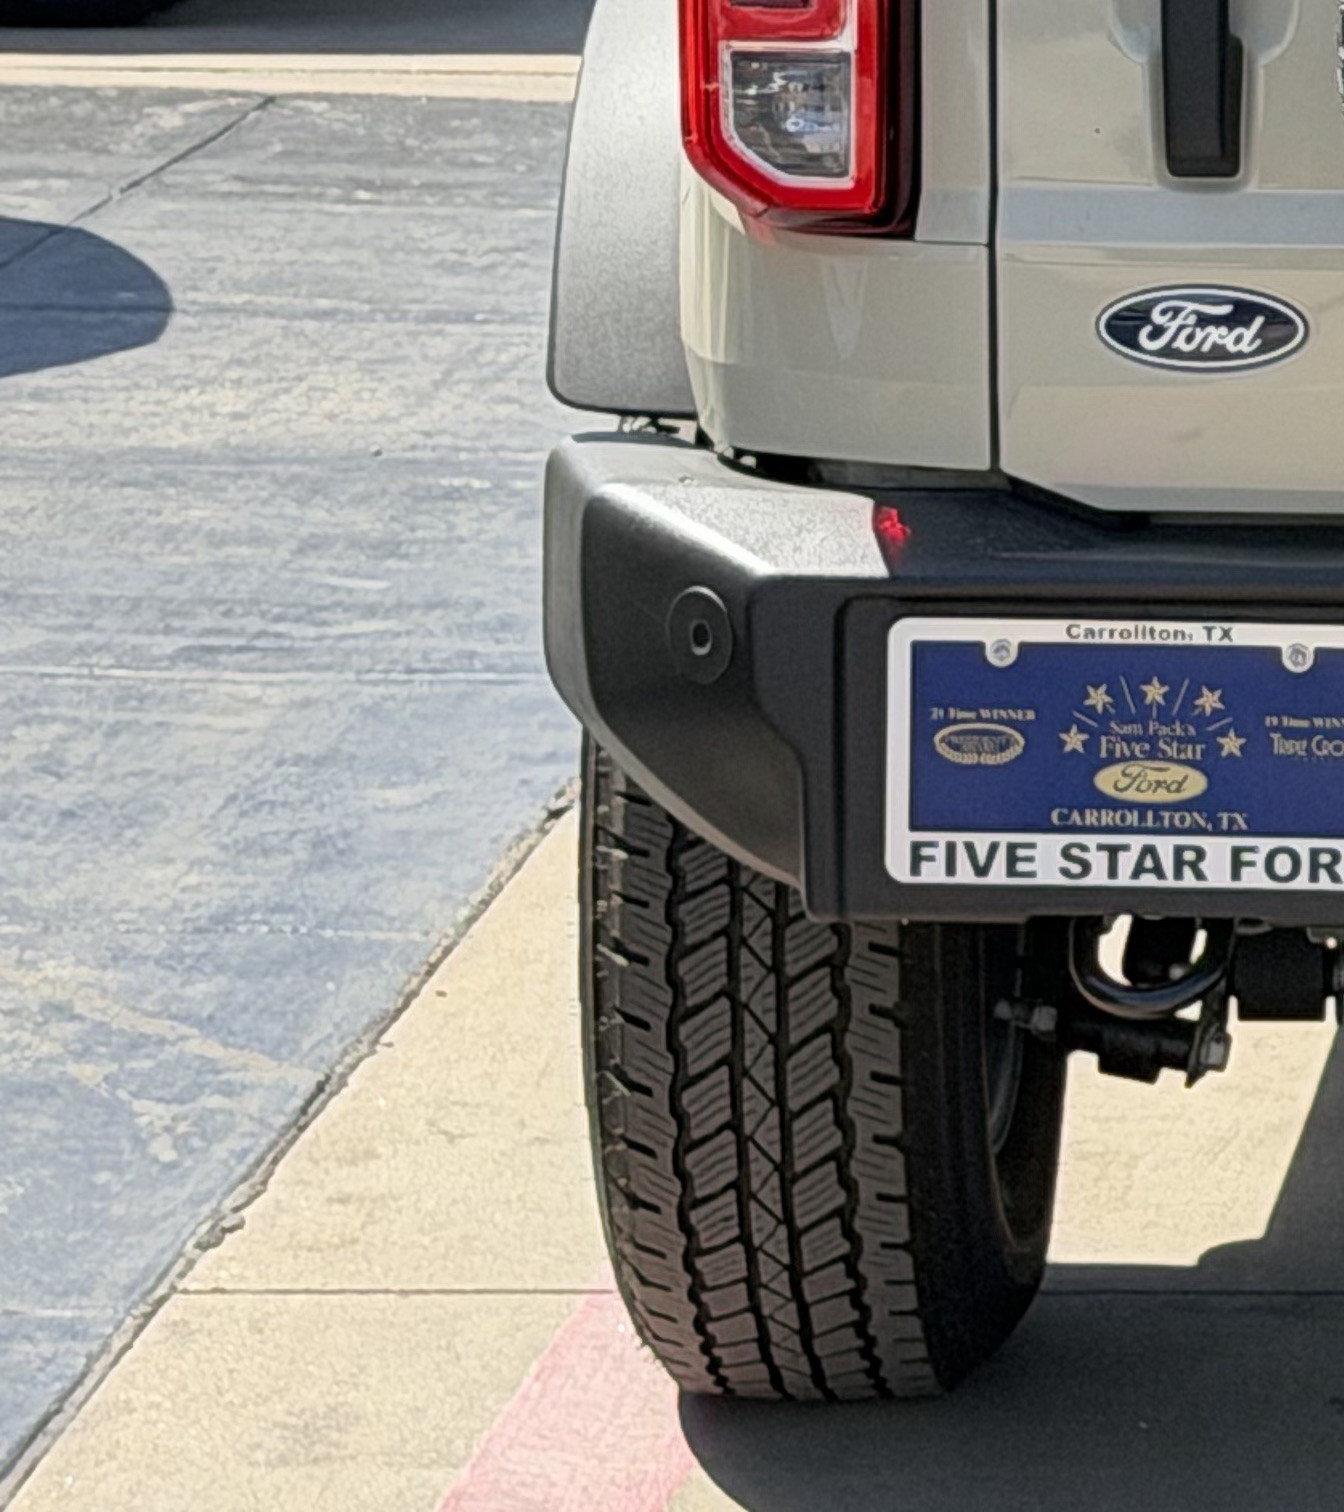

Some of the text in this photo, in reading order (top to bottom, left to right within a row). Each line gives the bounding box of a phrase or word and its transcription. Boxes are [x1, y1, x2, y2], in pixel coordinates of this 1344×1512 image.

[1138, 299, 1266, 354] Ford
[1065, 624, 1234, 643] Carrollton, TX
[1109, 719, 1144, 737] Sam
[1100, 735, 1207, 761] Five Star
[1113, 763, 1189, 794] Ford
[1050, 807, 1249, 832] CARROLLTON, TX
[909, 840, 1038, 879] FIVE
[1058, 842, 1208, 882] STAR
